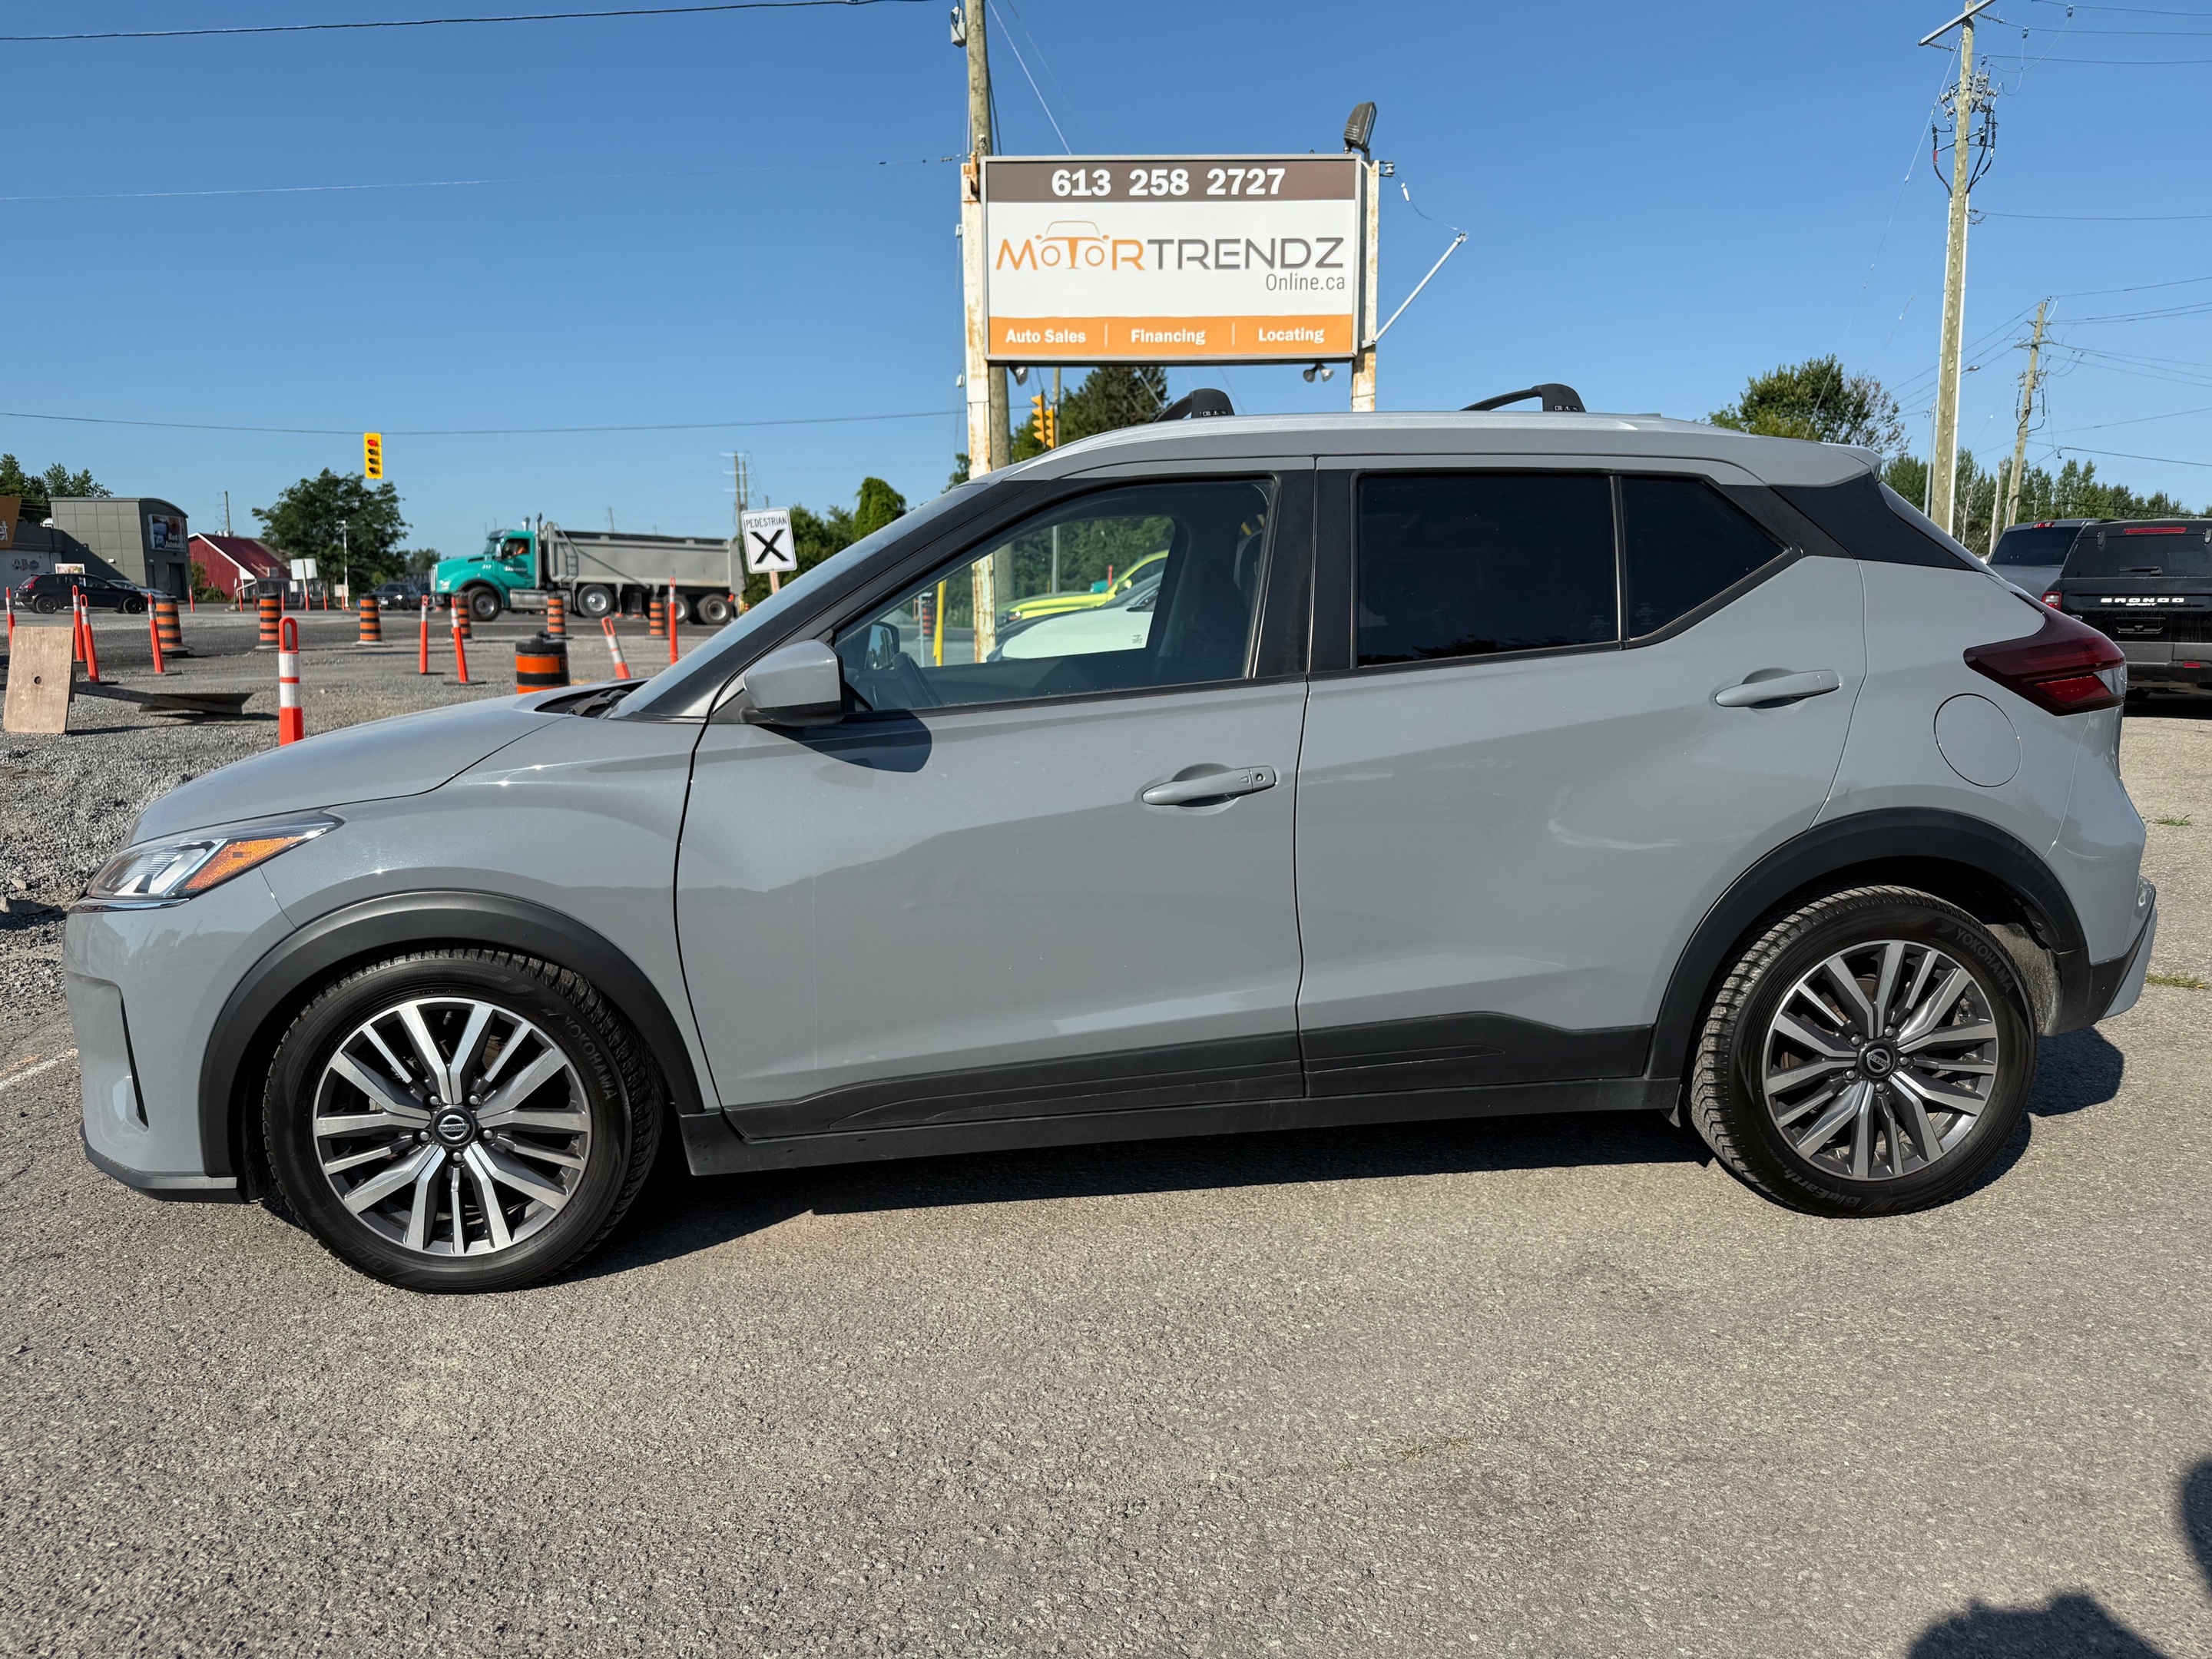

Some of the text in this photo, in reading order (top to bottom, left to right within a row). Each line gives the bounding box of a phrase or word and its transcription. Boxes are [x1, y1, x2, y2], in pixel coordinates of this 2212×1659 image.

[1051, 168, 1286, 197] 613 258 2727
[1266, 273, 1345, 291] Online.ca
[1005, 329, 1087, 344] Auto Sales
[1131, 329, 1207, 346] Financing
[1258, 327, 1326, 344] Locating
[746, 515, 788, 528] PEDESTRIAN
[1955, 928, 2015, 993] YOKOHAMA
[562, 1015, 618, 1101] YOKOHAMA
[1869, 1053, 1889, 1068] NISSAN
